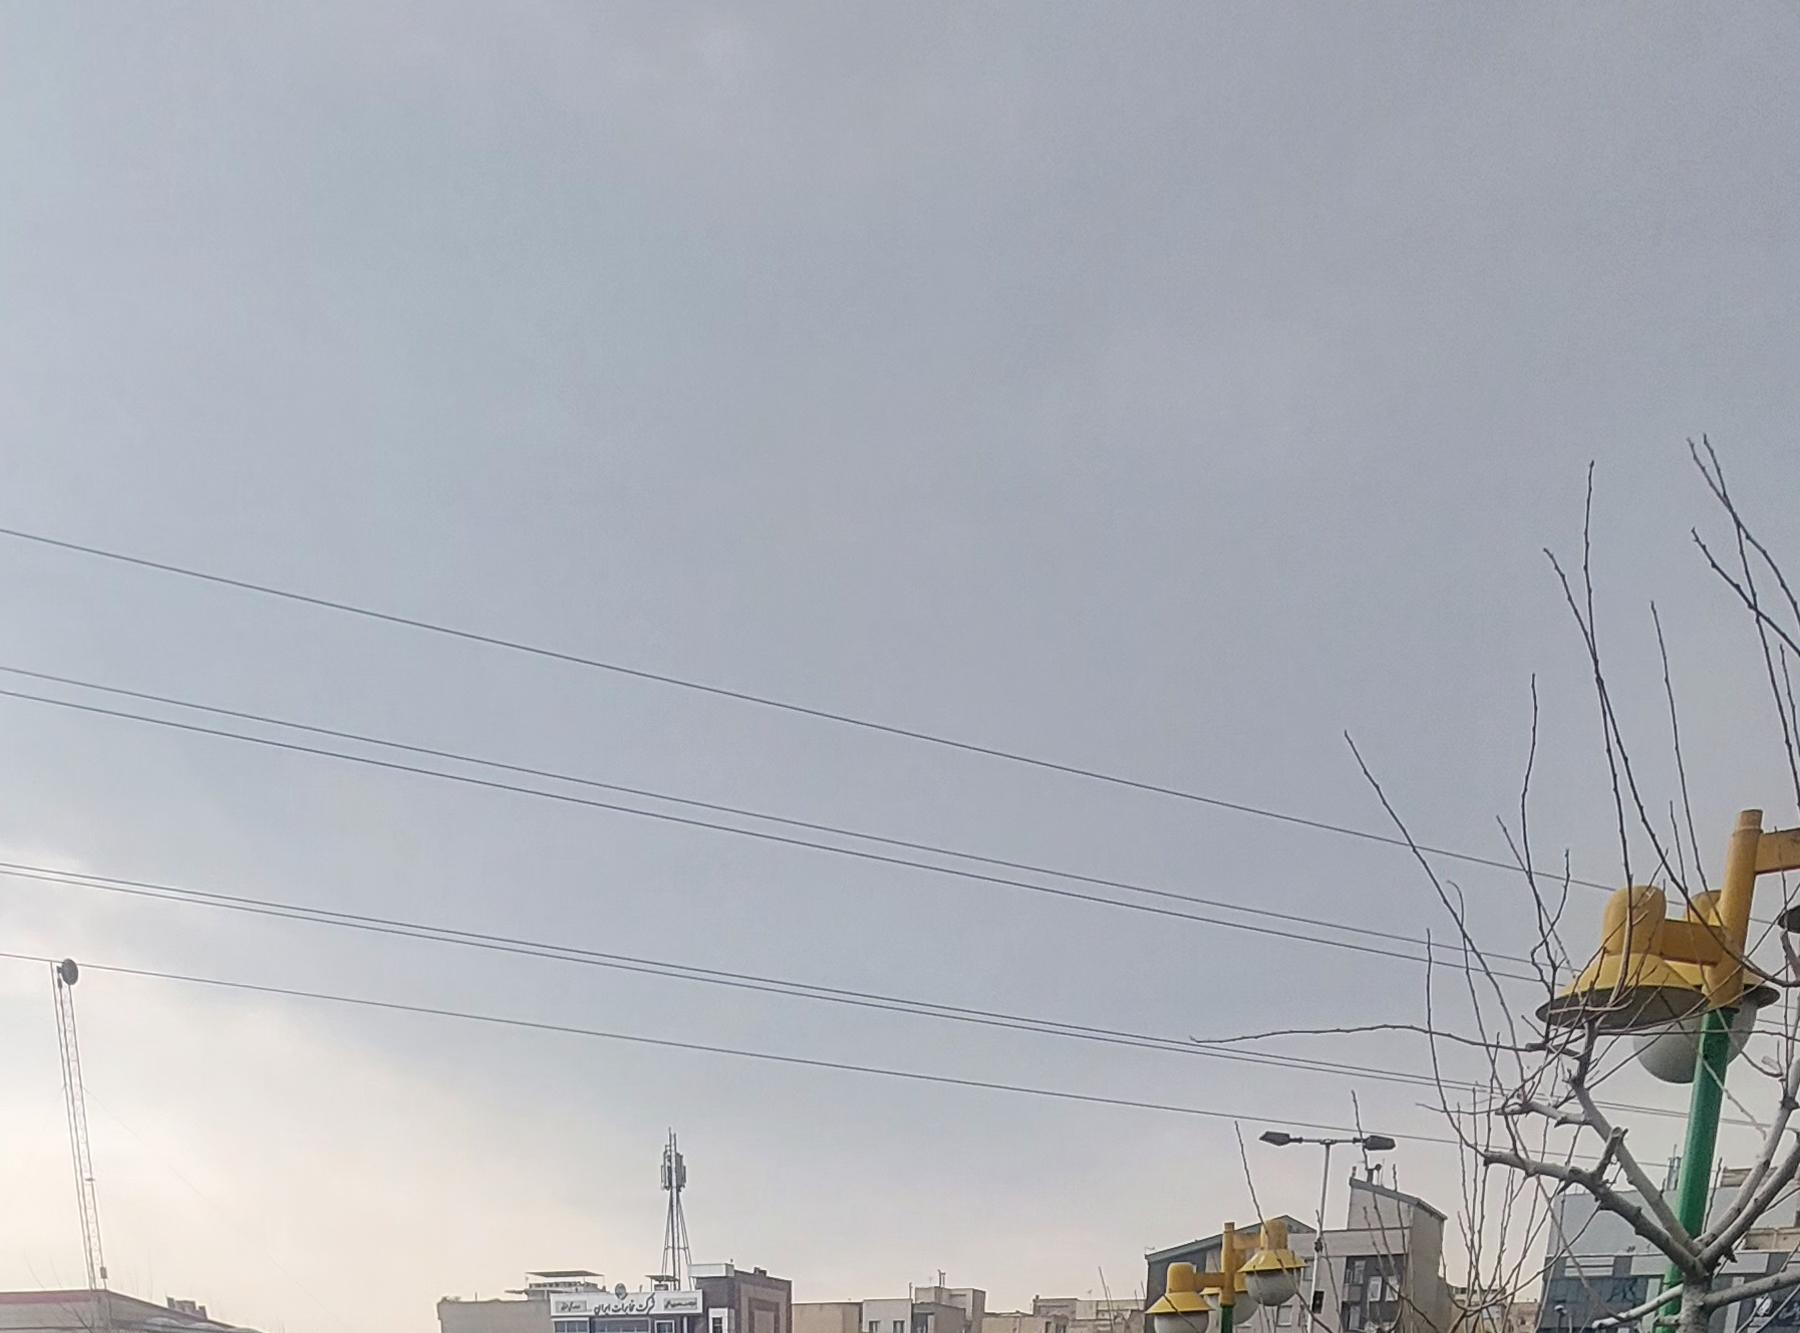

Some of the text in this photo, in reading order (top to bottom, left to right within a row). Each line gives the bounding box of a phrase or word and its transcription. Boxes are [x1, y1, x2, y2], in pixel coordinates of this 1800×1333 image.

[594, 1303, 610, 1316] ایران
[612, 1299, 635, 1315] مخابرات
[636, 1292, 655, 1315] شرکت
